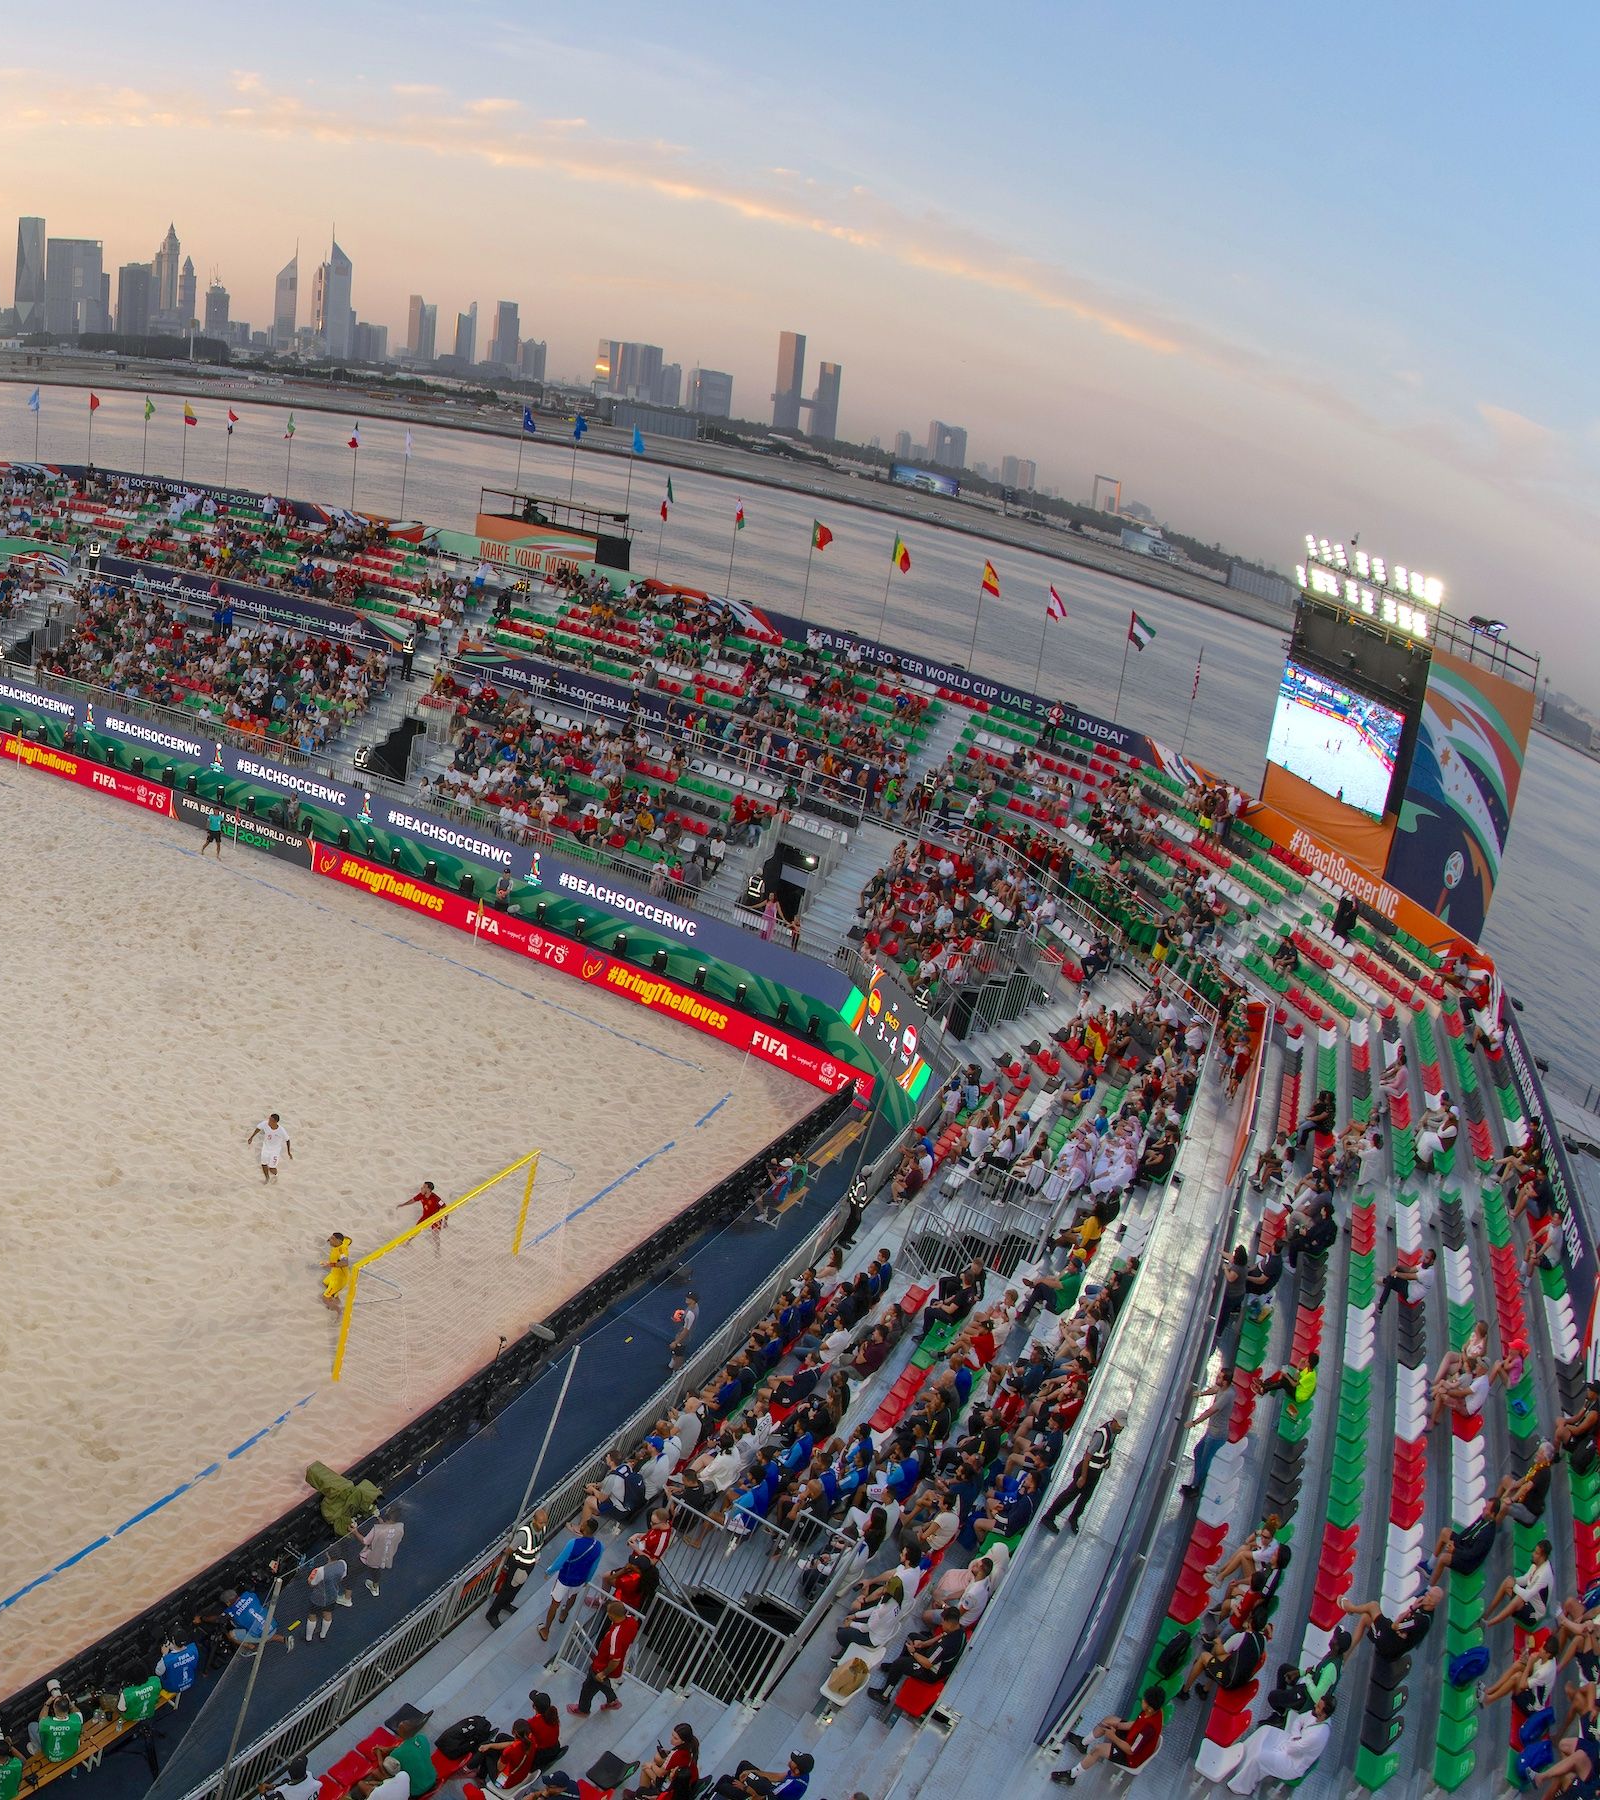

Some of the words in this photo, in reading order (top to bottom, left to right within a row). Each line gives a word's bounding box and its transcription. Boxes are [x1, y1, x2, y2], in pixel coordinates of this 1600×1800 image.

[229, 495, 256, 508] 2024
[480, 540, 511, 563] MAKE
[514, 548, 541, 570] YOUR
[503, 666, 528, 683] FIFA
[570, 685, 615, 709] SOCCER
[615, 698, 662, 722] WRLD
[806, 628, 833, 646] FFA
[835, 637, 875, 659] BECH
[877, 650, 923, 674] SOCER
[925, 664, 971, 690] WORLD
[973, 679, 998, 699] CUP
[1000, 690, 1032, 711] UAE
[1077, 718, 1125, 745] DUBAI
[105, 716, 201, 757] #BEACHSOCCERWC
[92, 770, 117, 790] FIFA
[236, 758, 347, 806] #BEACHSOCCERWC
[182, 798, 200, 812] FIFA
[255, 824, 285, 843] WORLD
[286, 834, 303, 849] CUP
[220, 824, 236, 838] AE
[237, 830, 269, 850] 2024
[388, 810, 513, 866] #BEACHSOCCERWC
[341, 860, 445, 913] #BringTheMoves
[1289, 828, 1400, 921] #BeachSoccerWC
[559, 872, 697, 937] #BEACHSOCCERWC
[544, 941, 567, 965] 75
[607, 965, 729, 1031] #BringTheMoves
[752, 1030, 789, 1061] FIFA
[818, 1074, 833, 1087] WHO
[876, 1021, 887, 1041] 3
[888, 1036, 898, 1055] 4
[272, 1155, 278, 1164] 5
[1562, 1206, 1584, 1270] DUBAI
[135, 1685, 154, 1697] PHOTO
